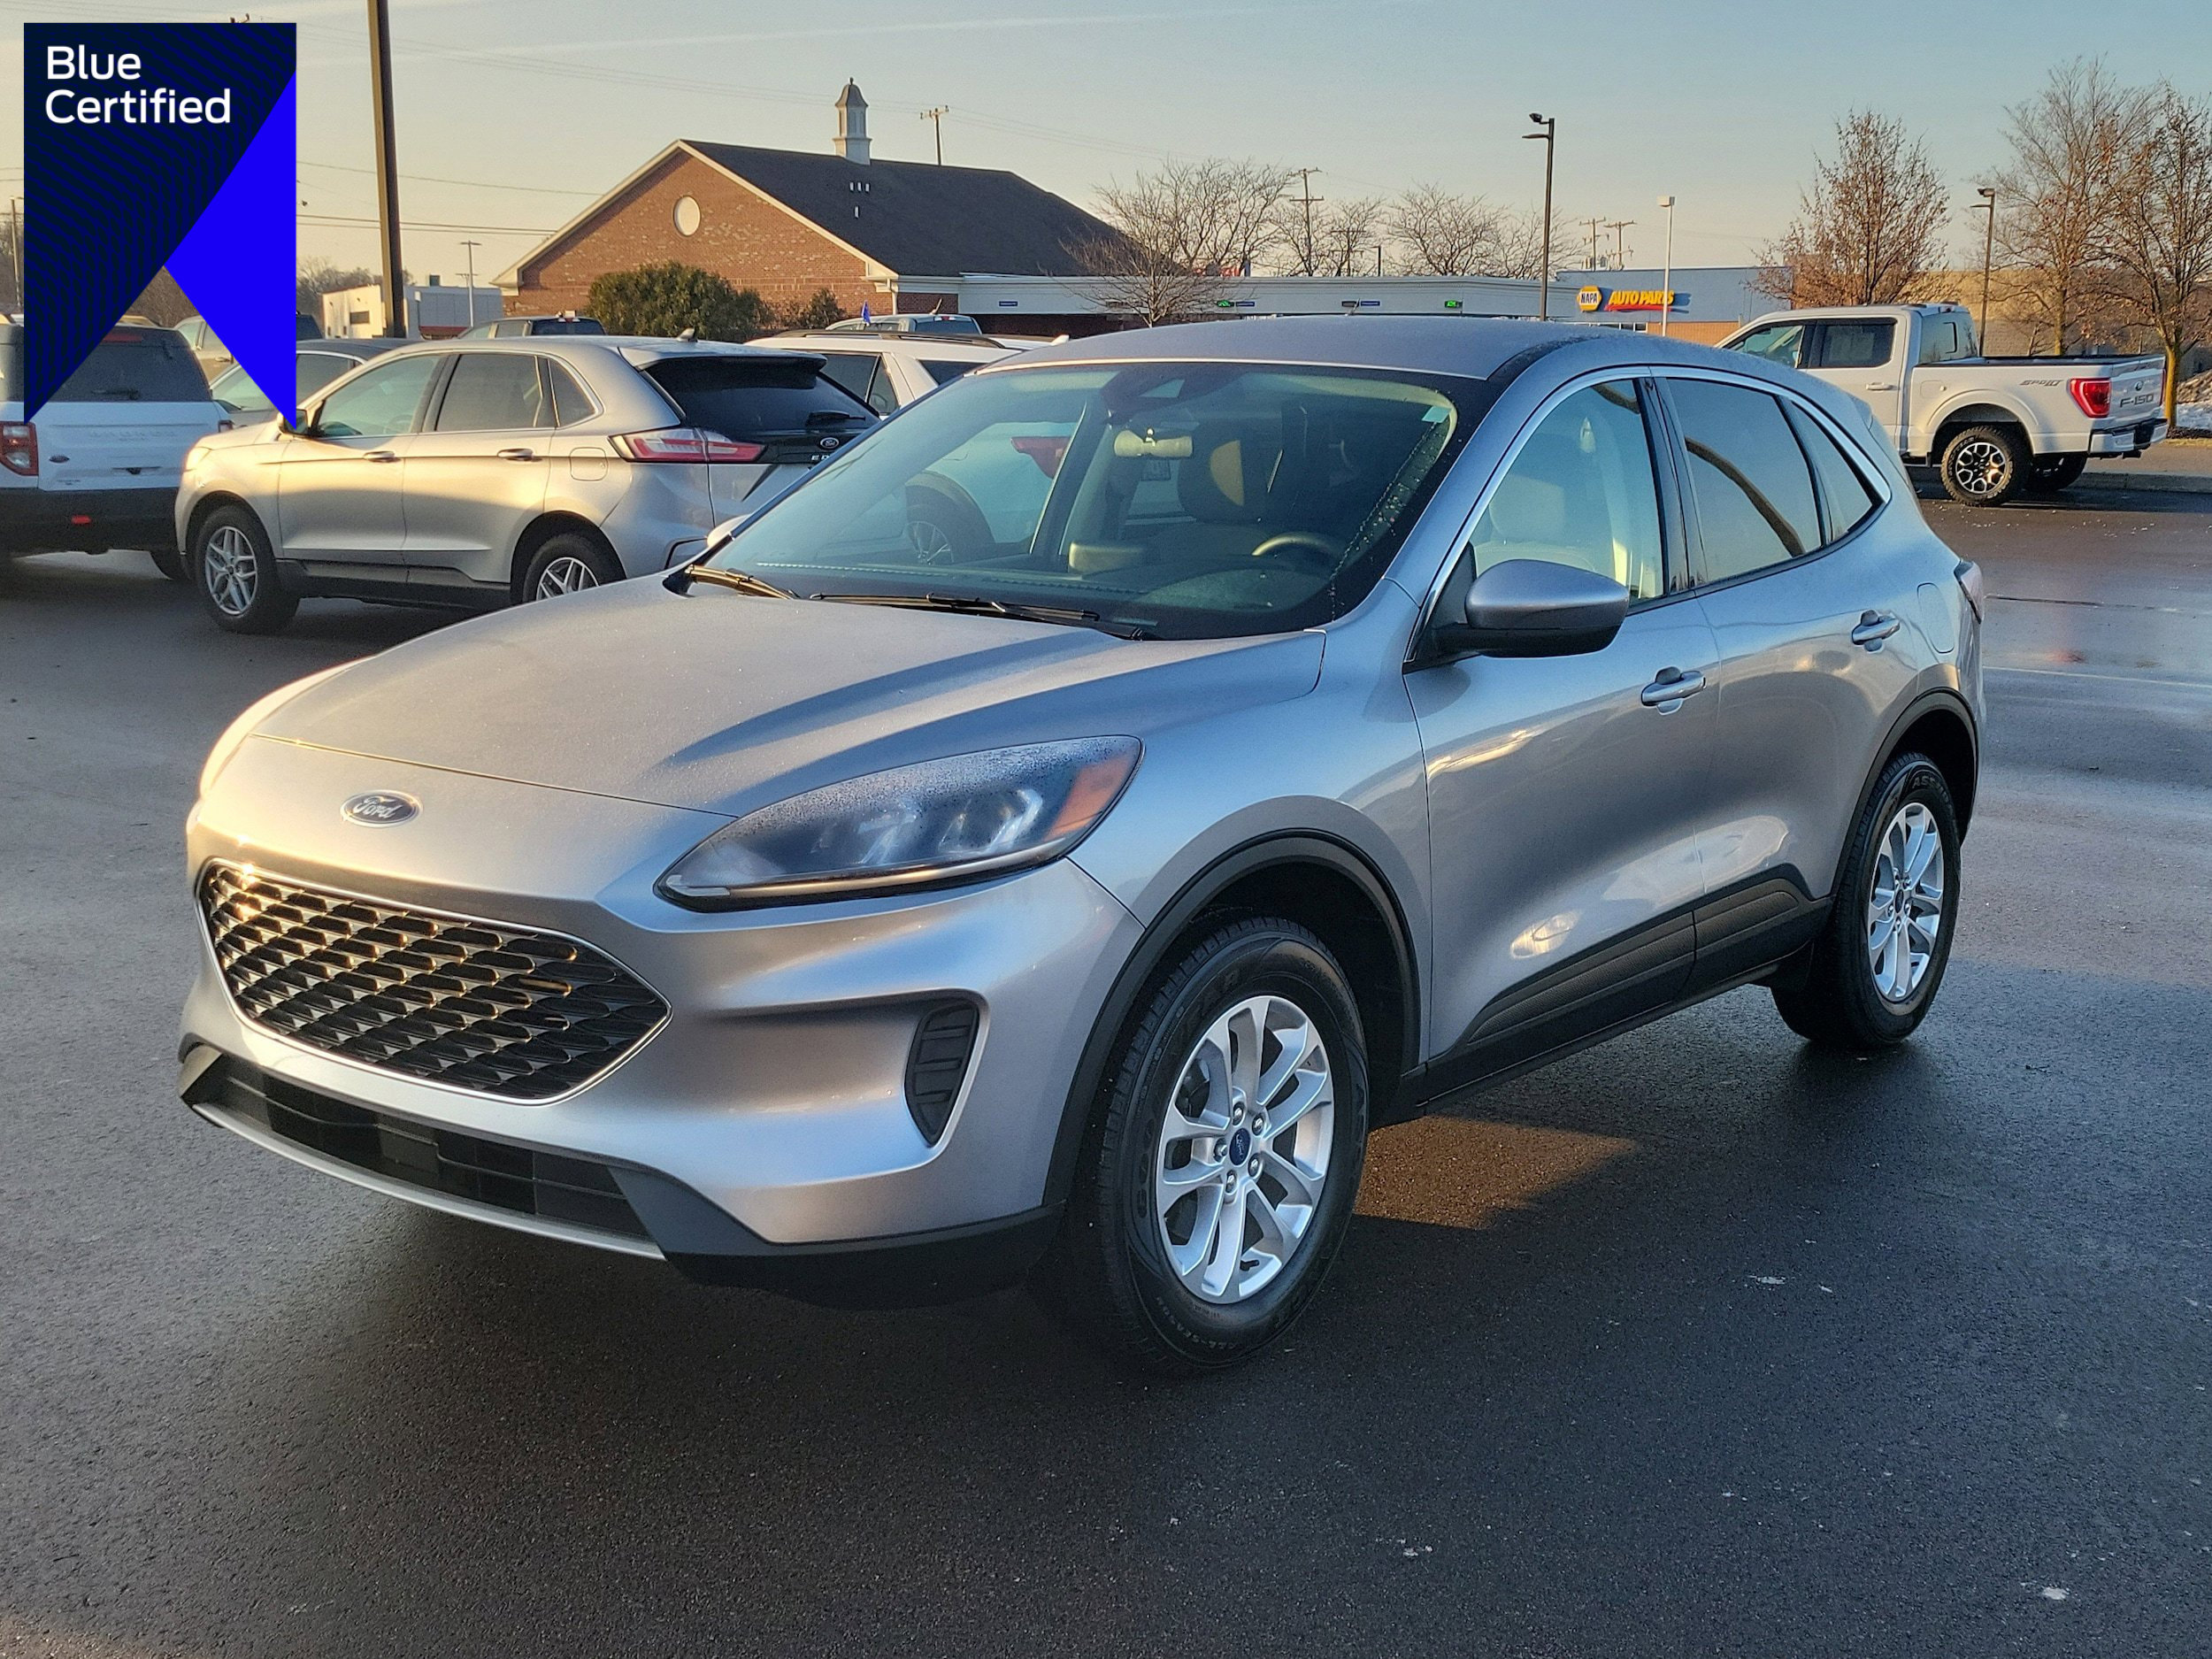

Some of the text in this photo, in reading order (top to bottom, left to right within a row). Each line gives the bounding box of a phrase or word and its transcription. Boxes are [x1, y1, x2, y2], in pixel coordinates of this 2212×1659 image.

[1580, 293, 1597, 303] NAPA
[1609, 290, 1639, 304] AUTO
[2120, 394, 2154, 408] F-150
[352, 795, 403, 819] Ford
